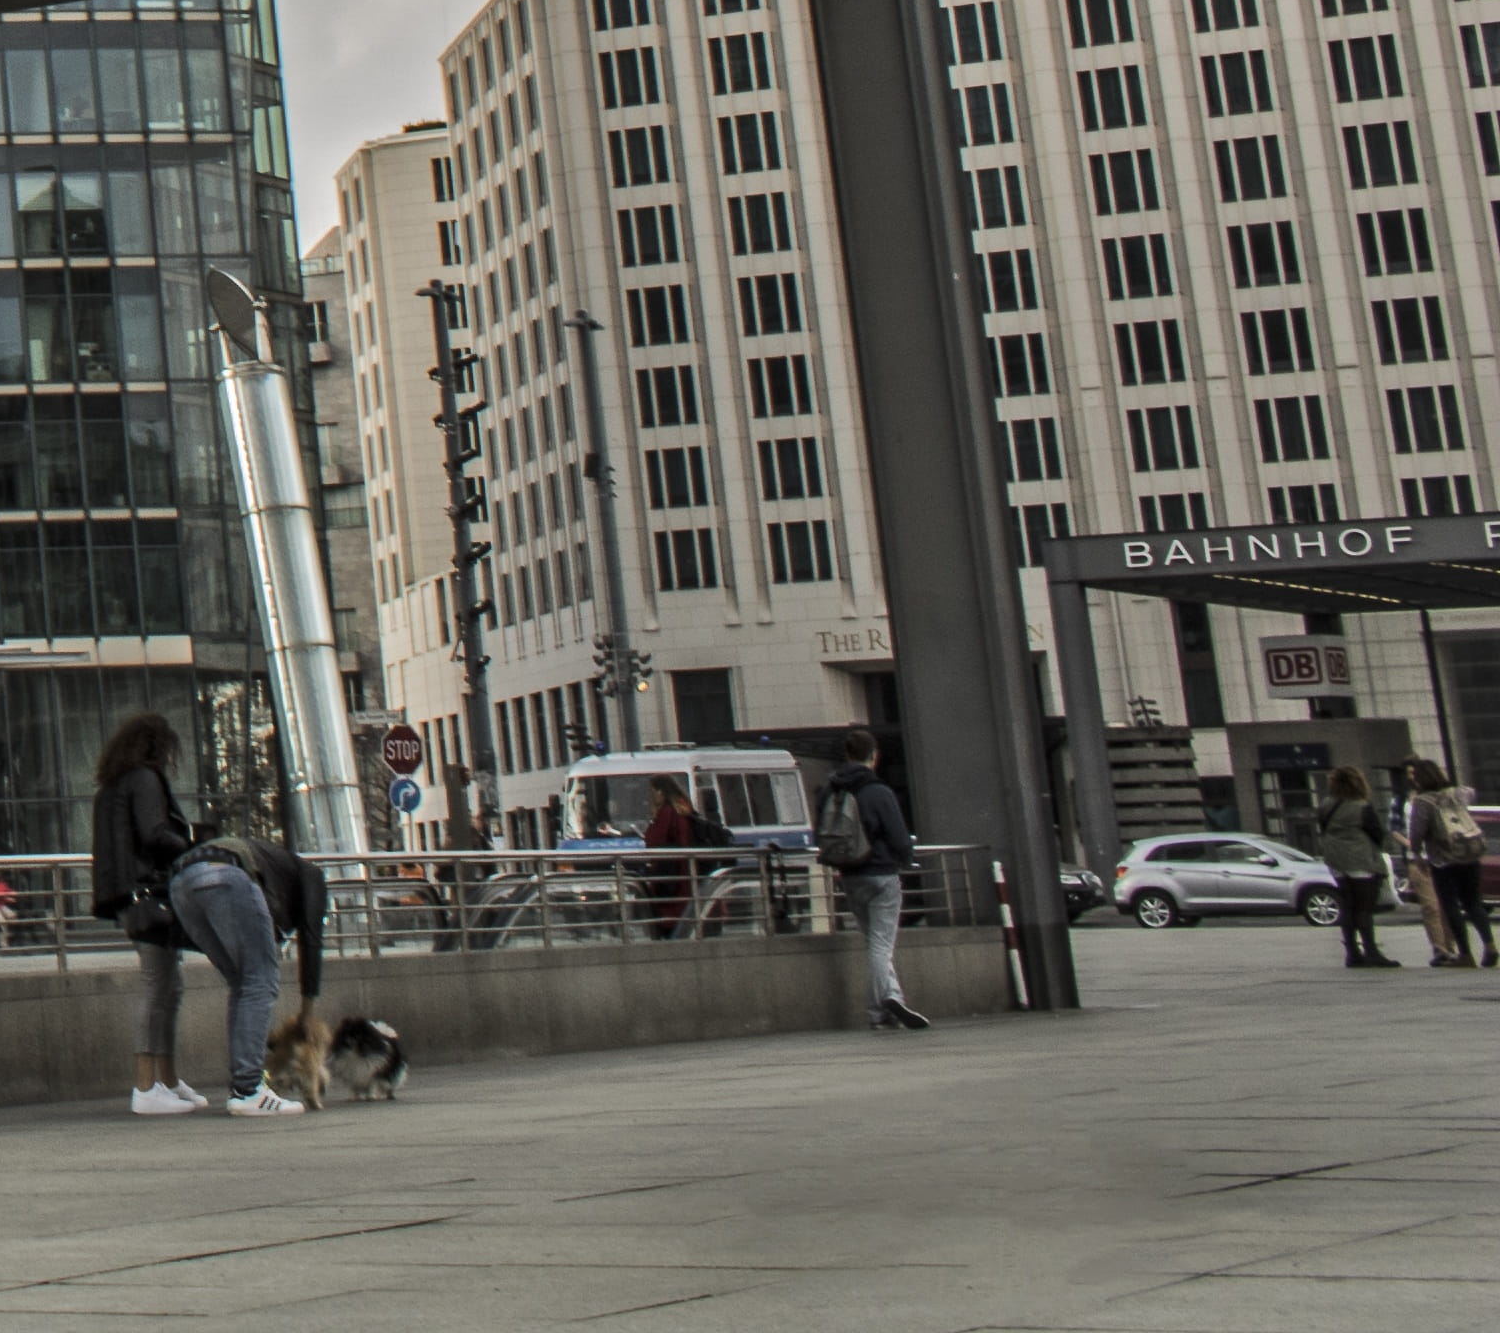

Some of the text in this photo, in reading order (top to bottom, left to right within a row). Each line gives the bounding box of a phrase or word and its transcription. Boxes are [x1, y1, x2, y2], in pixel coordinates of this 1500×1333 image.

[1123, 525, 1414, 569] BAHNHOF
[815, 630, 863, 654] THE
[1271, 656, 1317, 682] DB
[1328, 650, 1348, 680] DB
[386, 739, 420, 761] STOP
